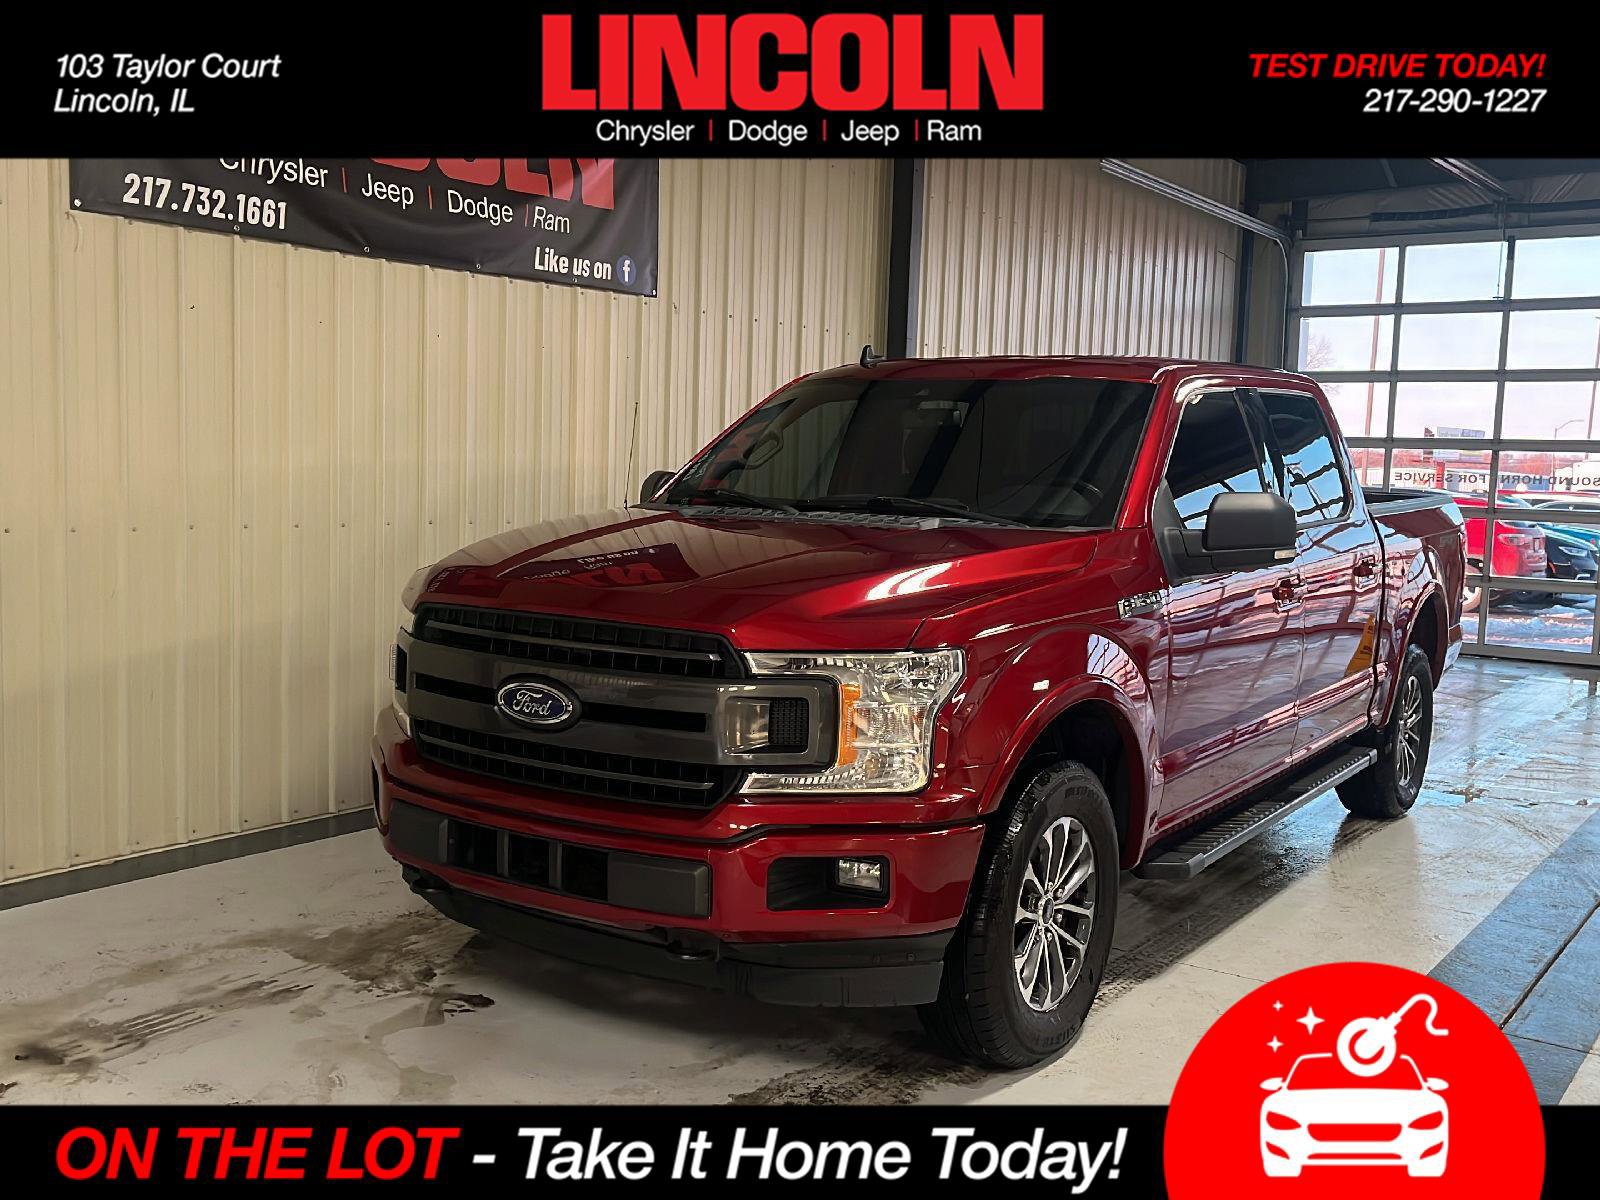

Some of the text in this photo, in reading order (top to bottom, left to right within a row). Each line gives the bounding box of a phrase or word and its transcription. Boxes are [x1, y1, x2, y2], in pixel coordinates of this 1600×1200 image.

[122, 173, 288, 230] 217.732.1661
[361, 173, 414, 210] Jeep
[447, 189, 514, 226] Dodge
[533, 206, 571, 234] Ram
[534, 246, 569, 275] Like
[572, 260, 590, 278] us
[593, 262, 612, 281] on
[512, 689, 553, 716] Ford
